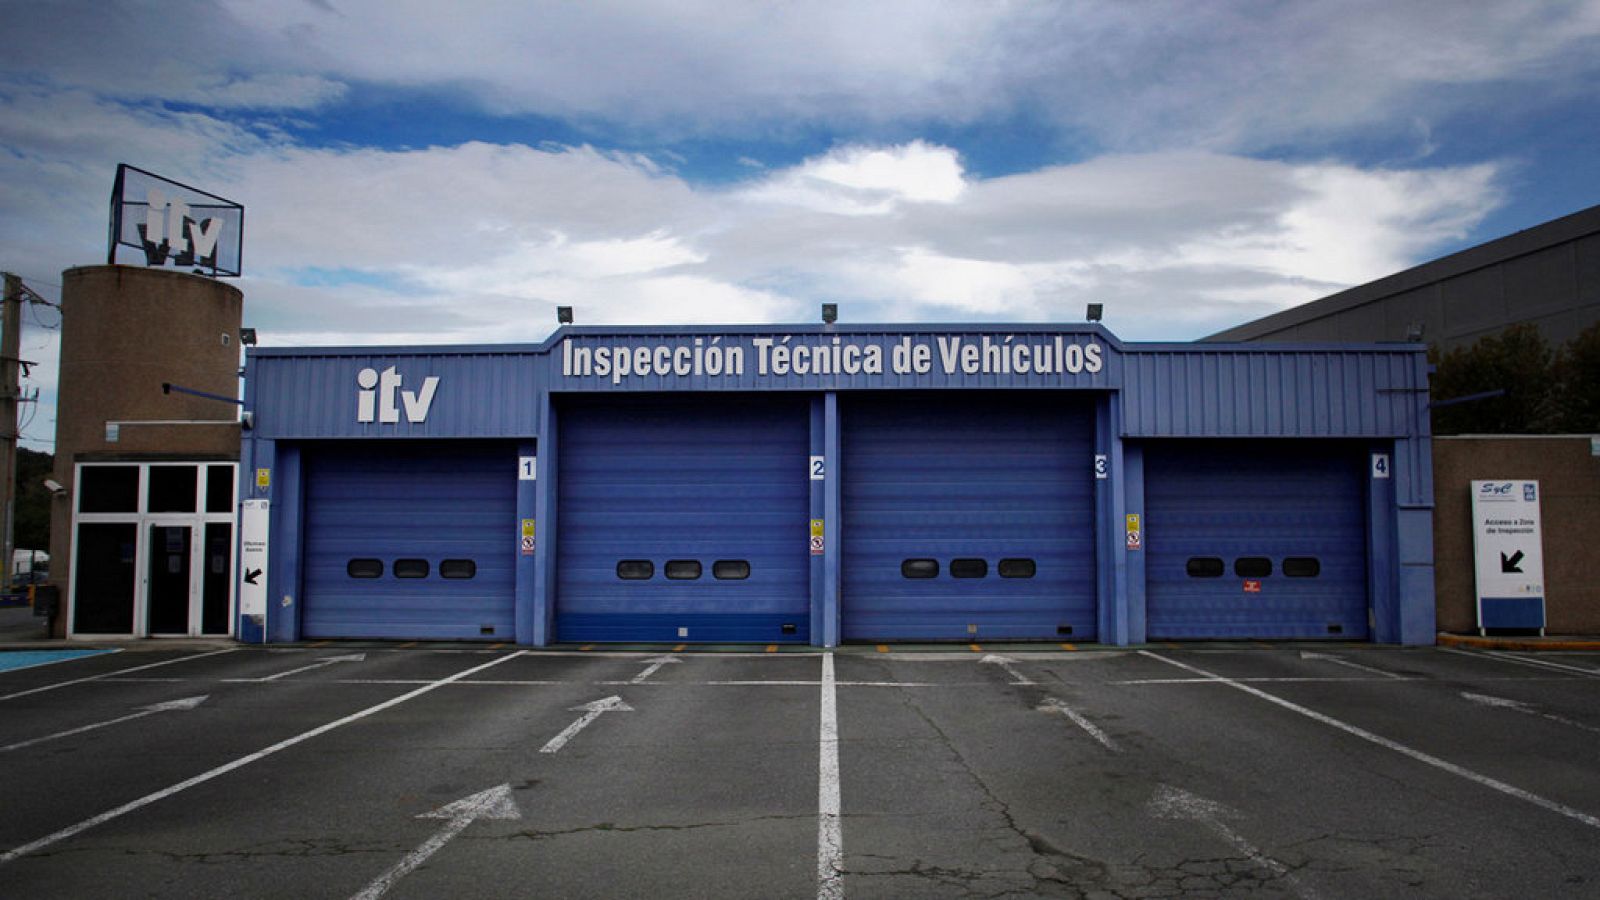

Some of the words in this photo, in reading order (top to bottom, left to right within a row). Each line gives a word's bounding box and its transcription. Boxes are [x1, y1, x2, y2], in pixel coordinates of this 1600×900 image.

[146, 188, 223, 257] itv
[563, 336, 744, 384] Inspección
[752, 336, 882, 375] Técnica
[892, 336, 931, 374] de
[937, 336, 1103, 374] Vehículos
[357, 365, 440, 423] itv
[524, 461, 531, 475] 1
[813, 460, 825, 475] 2
[1096, 459, 1106, 474] 3
[1376, 458, 1386, 473] 4
